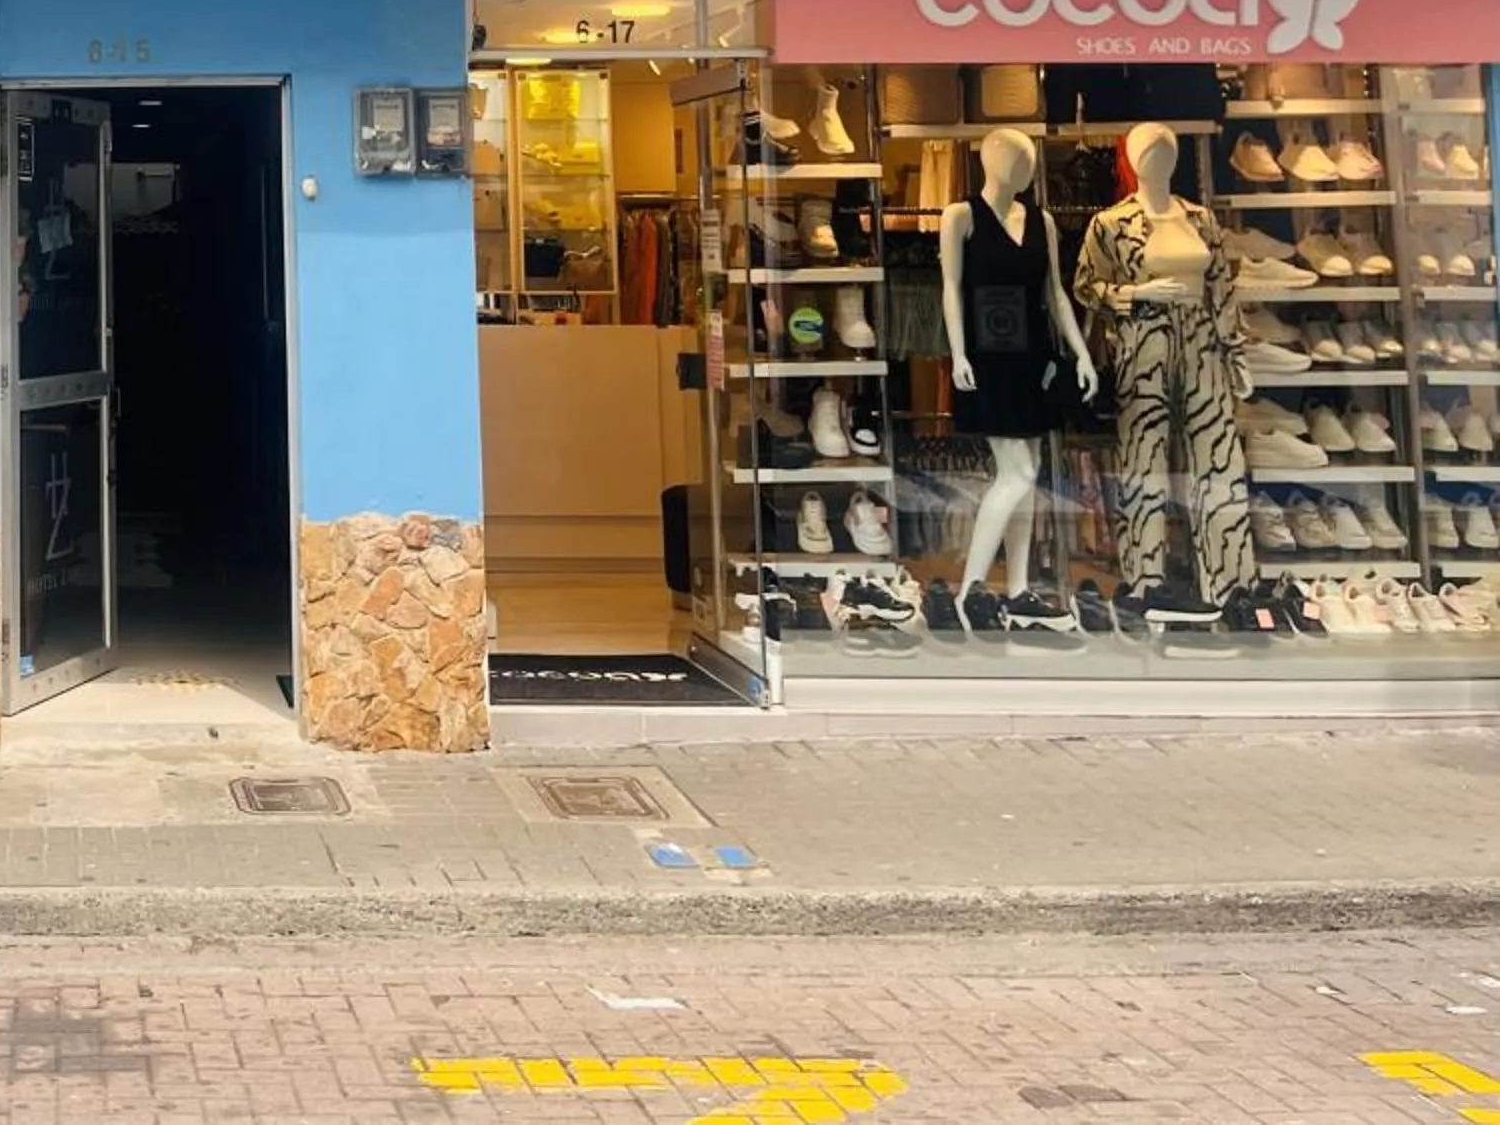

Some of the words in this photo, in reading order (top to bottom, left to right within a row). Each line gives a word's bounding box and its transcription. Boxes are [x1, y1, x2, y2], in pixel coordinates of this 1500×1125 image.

[1076, 37, 1136, 55] SHOES
[1148, 37, 1191, 55] AND
[1201, 37, 1252, 55] BAGS
